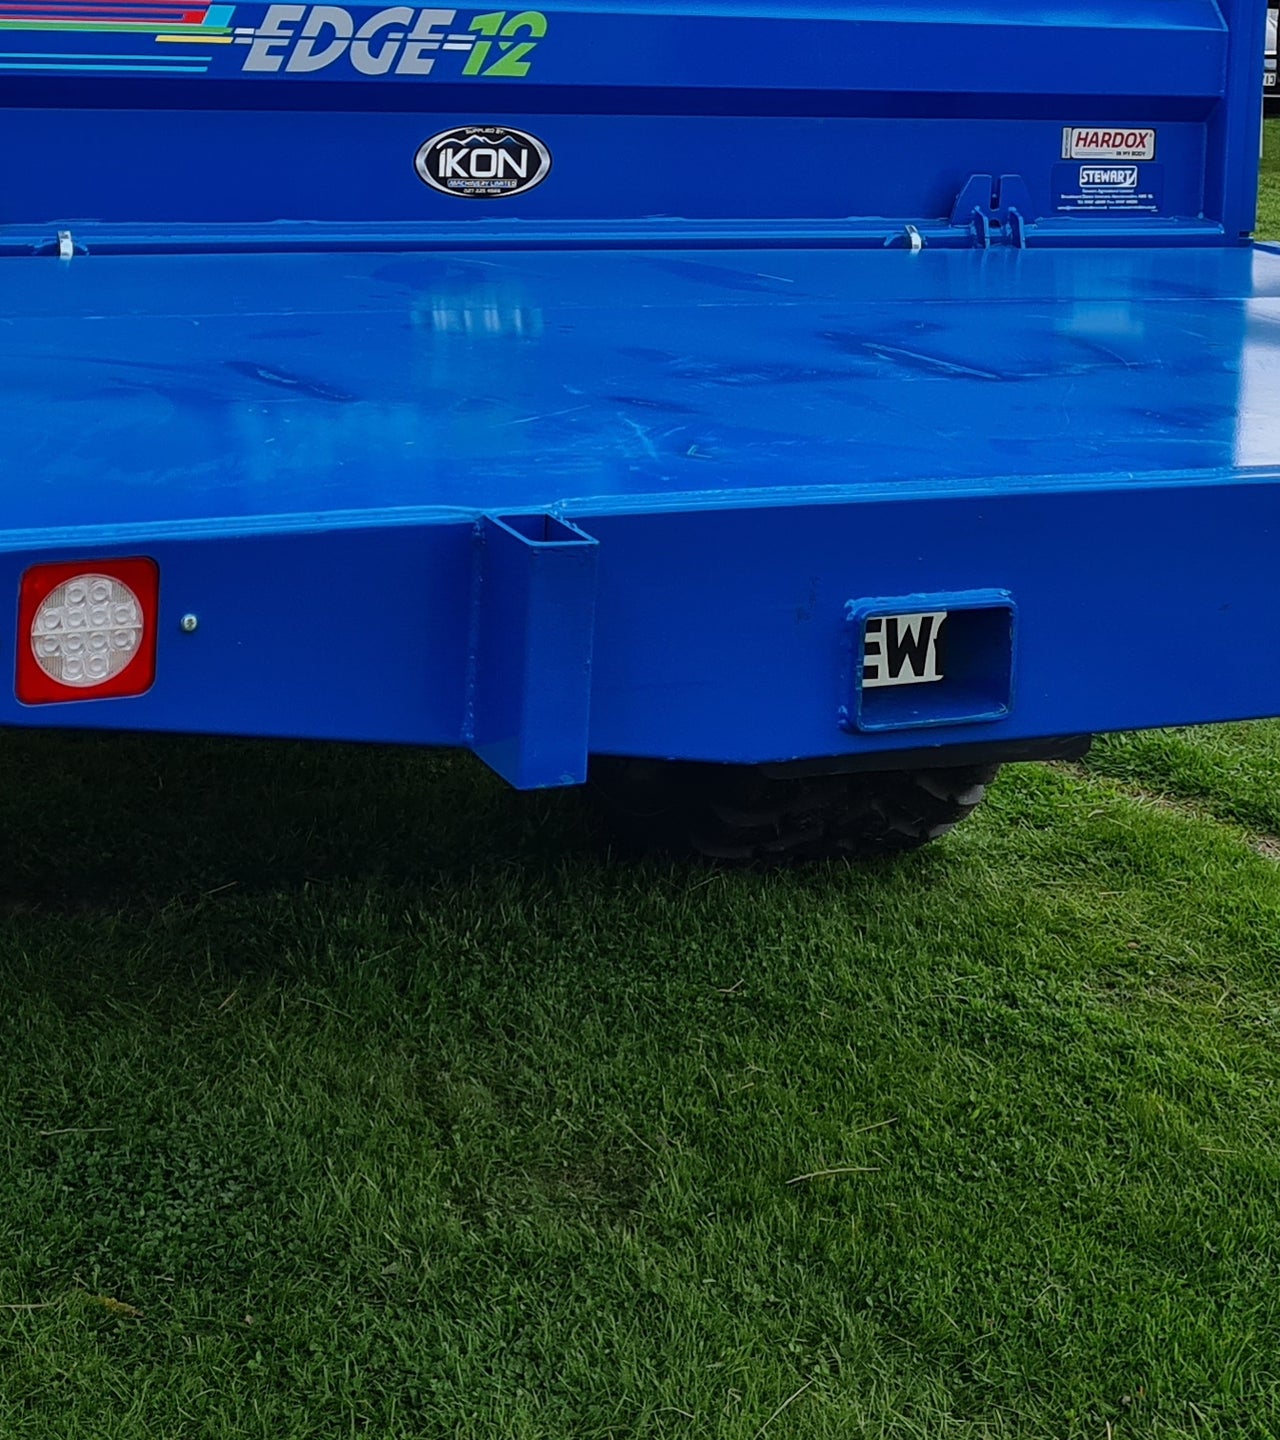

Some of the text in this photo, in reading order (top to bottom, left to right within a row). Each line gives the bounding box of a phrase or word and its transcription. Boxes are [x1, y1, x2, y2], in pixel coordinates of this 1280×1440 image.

[1074, 131, 1149, 148] HARDOX
[438, 148, 528, 178] IKON
[1081, 169, 1137, 186] STEWART
